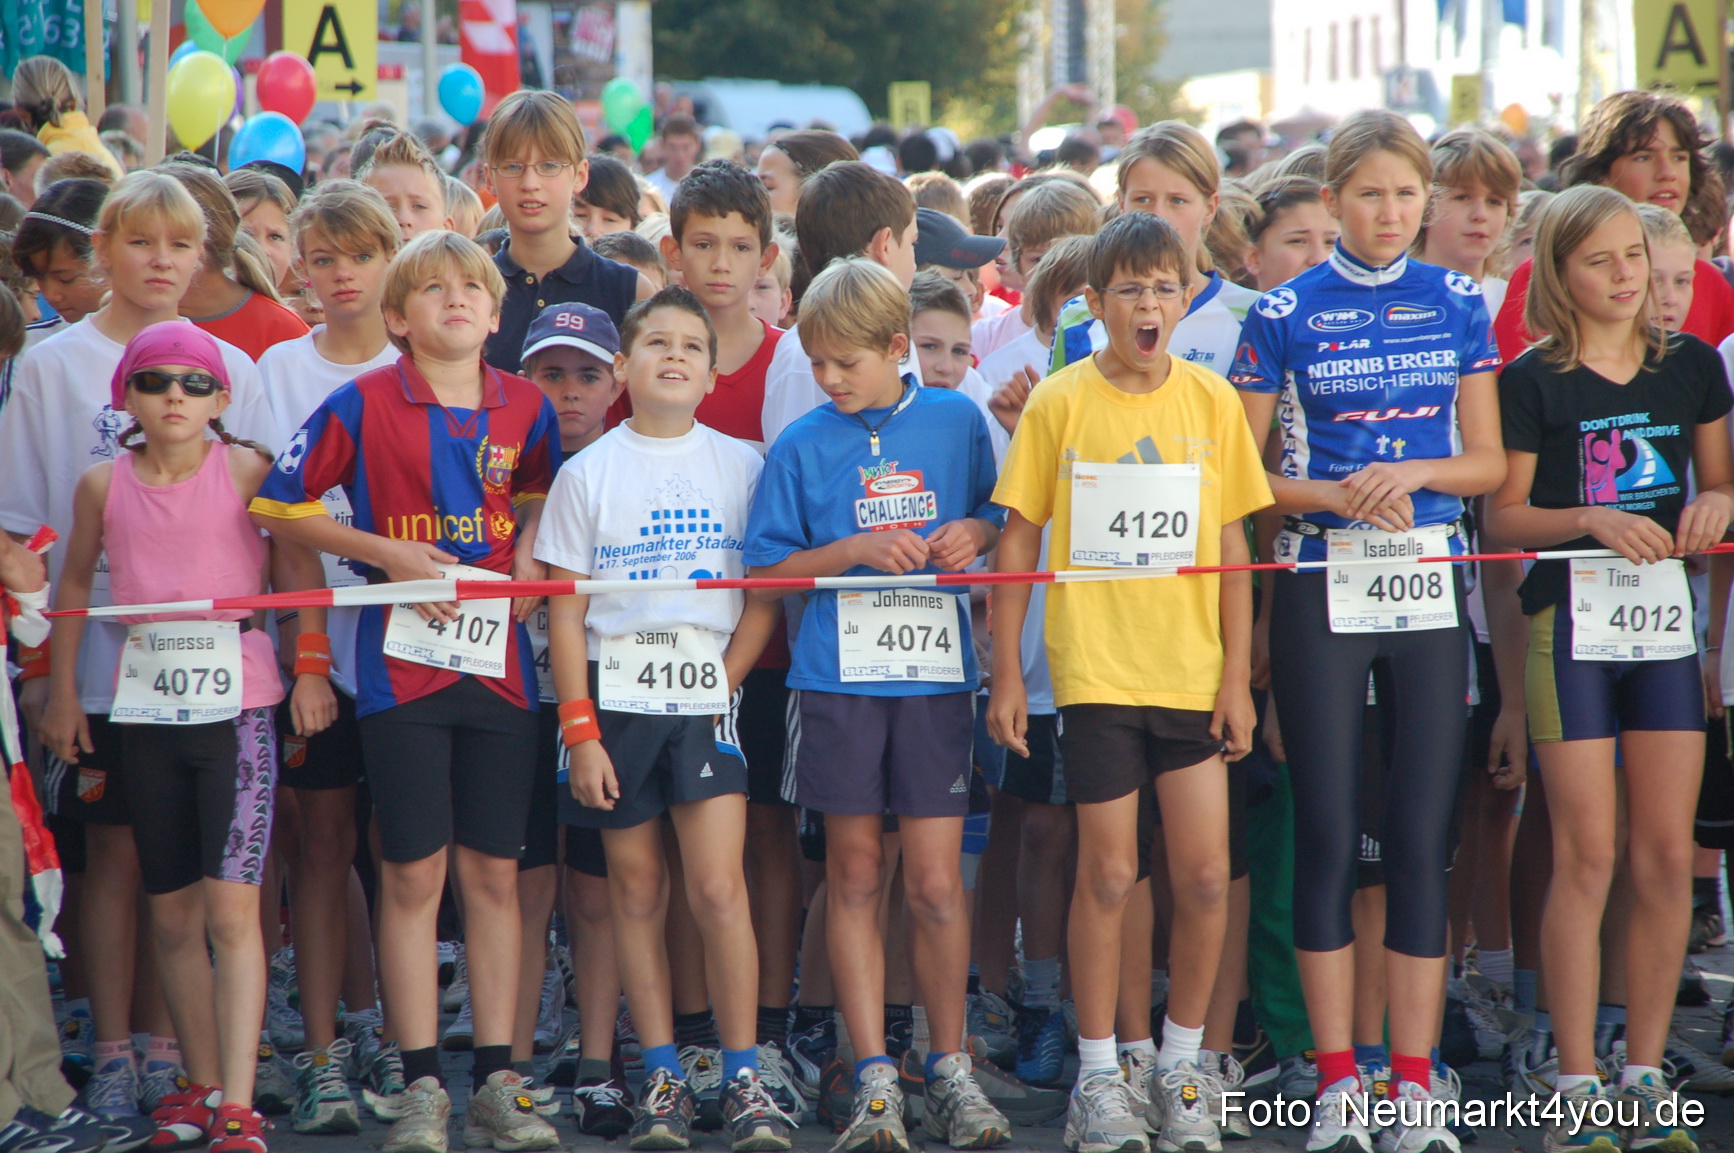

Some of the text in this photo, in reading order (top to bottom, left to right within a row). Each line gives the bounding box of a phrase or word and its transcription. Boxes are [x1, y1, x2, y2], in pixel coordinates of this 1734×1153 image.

[305, 5, 354, 69] A
[1656, 4, 1707, 68] A
[555, 312, 584, 330] 99
[1388, 310, 1437, 321] maxim
[1383, 332, 1452, 348] www.nuernberger.de
[1309, 371, 1456, 396] VERSICHERUNG
[1332, 405, 1441, 422] FUJI
[1647, 424, 1680, 438] DRIVE
[859, 494, 934, 525] CHALLENGE
[388, 506, 484, 543] unicef
[876, 522, 922, 531] ROTH
[1109, 511, 1188, 538] 4120
[600, 535, 692, 559] Neumarkter
[1364, 537, 1424, 557] Isabella
[606, 551, 698, 568] 17. September 2006
[1073, 551, 1193, 561] BOCK PFLEIDERER
[1334, 570, 1349, 583] Ju
[1607, 568, 1640, 587] Tina
[1367, 572, 1443, 602] 4008
[873, 590, 943, 609] Johannes
[1577, 598, 1591, 612] Ju
[1609, 605, 1682, 631] 4012
[428, 613, 500, 646] 4107
[844, 621, 859, 634] Ju
[149, 632, 214, 651] Vanessa
[636, 631, 678, 648] Samy
[877, 625, 952, 653] 4074
[125, 664, 138, 678] Ju
[463, 656, 504, 671] PFLEIDERER
[605, 656, 619, 669] Ju
[843, 666, 961, 676] BOCK PFLEIDERER
[154, 668, 231, 696] 4079
[637, 662, 717, 689] 4108
[192, 706, 239, 717] PFLEIDERER
[1182, 1086, 1197, 1099] S
[1374, 1082, 1388, 1095] S
[518, 1097, 532, 1107] S
[871, 1100, 885, 1110] S
